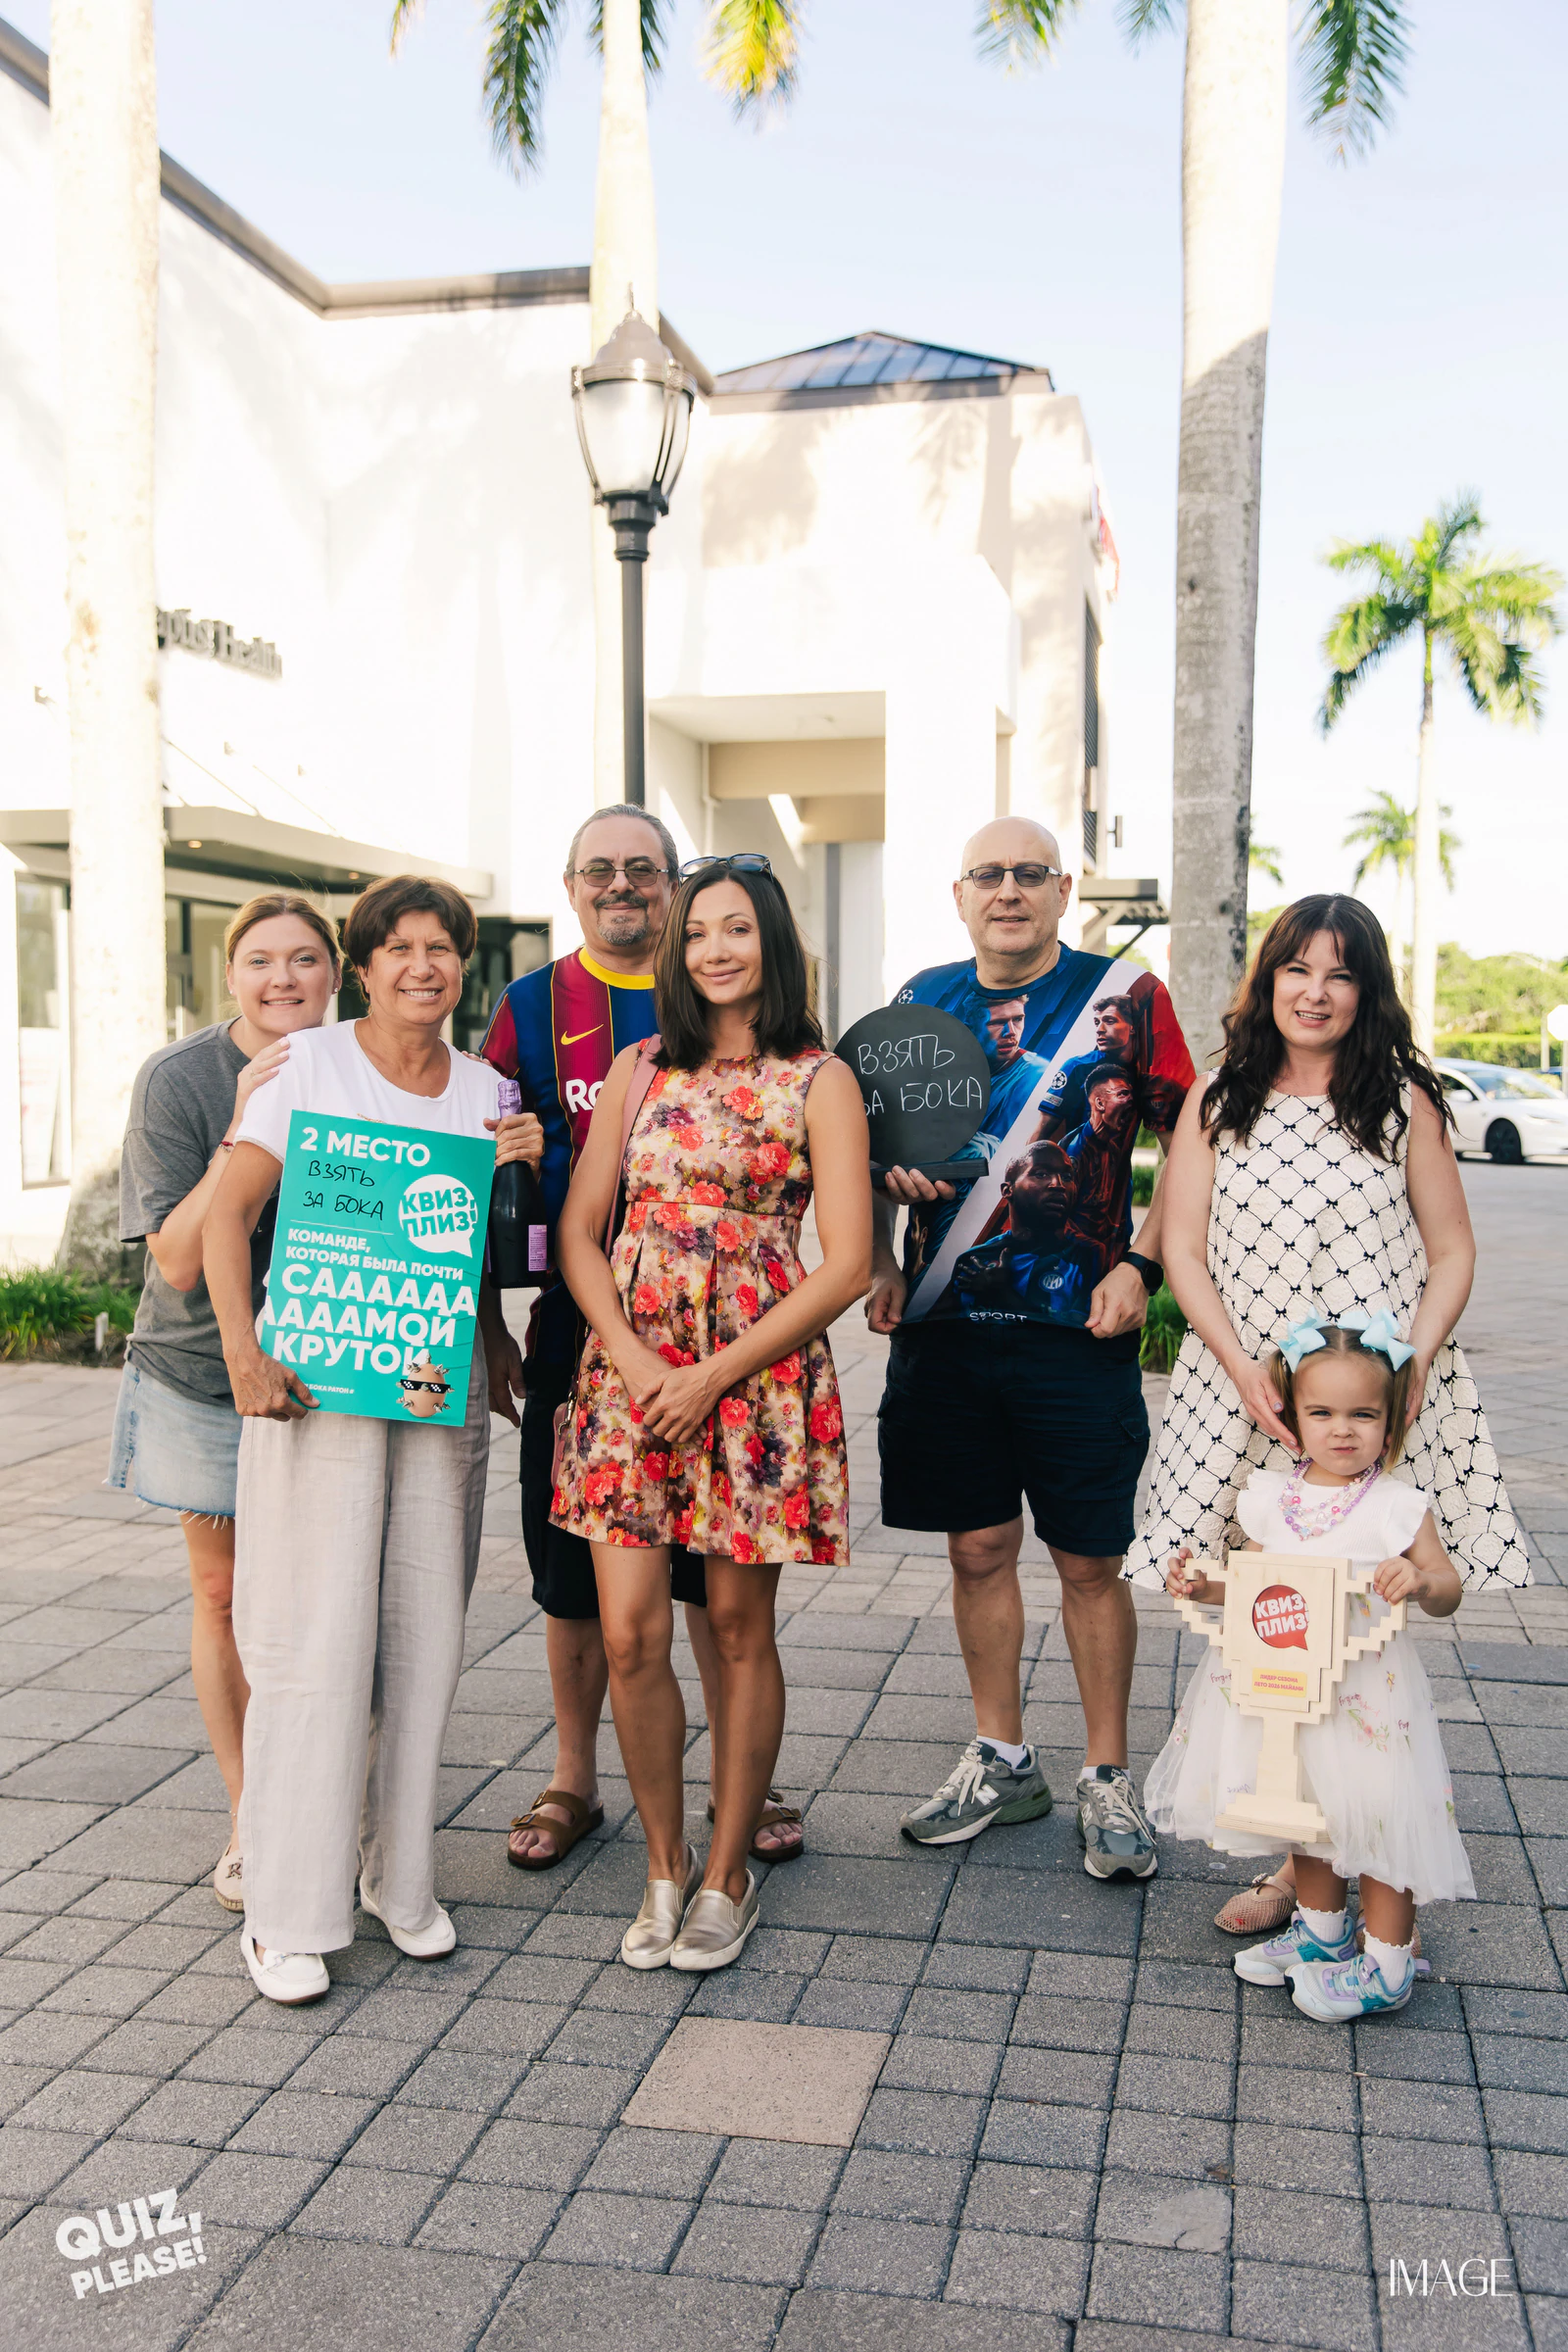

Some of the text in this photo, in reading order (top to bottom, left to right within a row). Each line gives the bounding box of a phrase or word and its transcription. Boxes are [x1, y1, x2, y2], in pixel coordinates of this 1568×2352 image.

[858, 1034, 956, 1074] ВЗЯТЬ
[900, 1076, 983, 1112] БОКА
[300, 1126, 431, 1167] 2 МЕСТО
[308, 1160, 375, 1187] ВЗЯТЬ
[303, 1191, 383, 1220] ЗА БОКА
[287, 1228, 370, 1252] КОМАНДЕ,
[285, 1246, 463, 1281] КОТОРАЯ БЫЛА ПОЧТИ
[281, 1263, 476, 1316] САААААА
